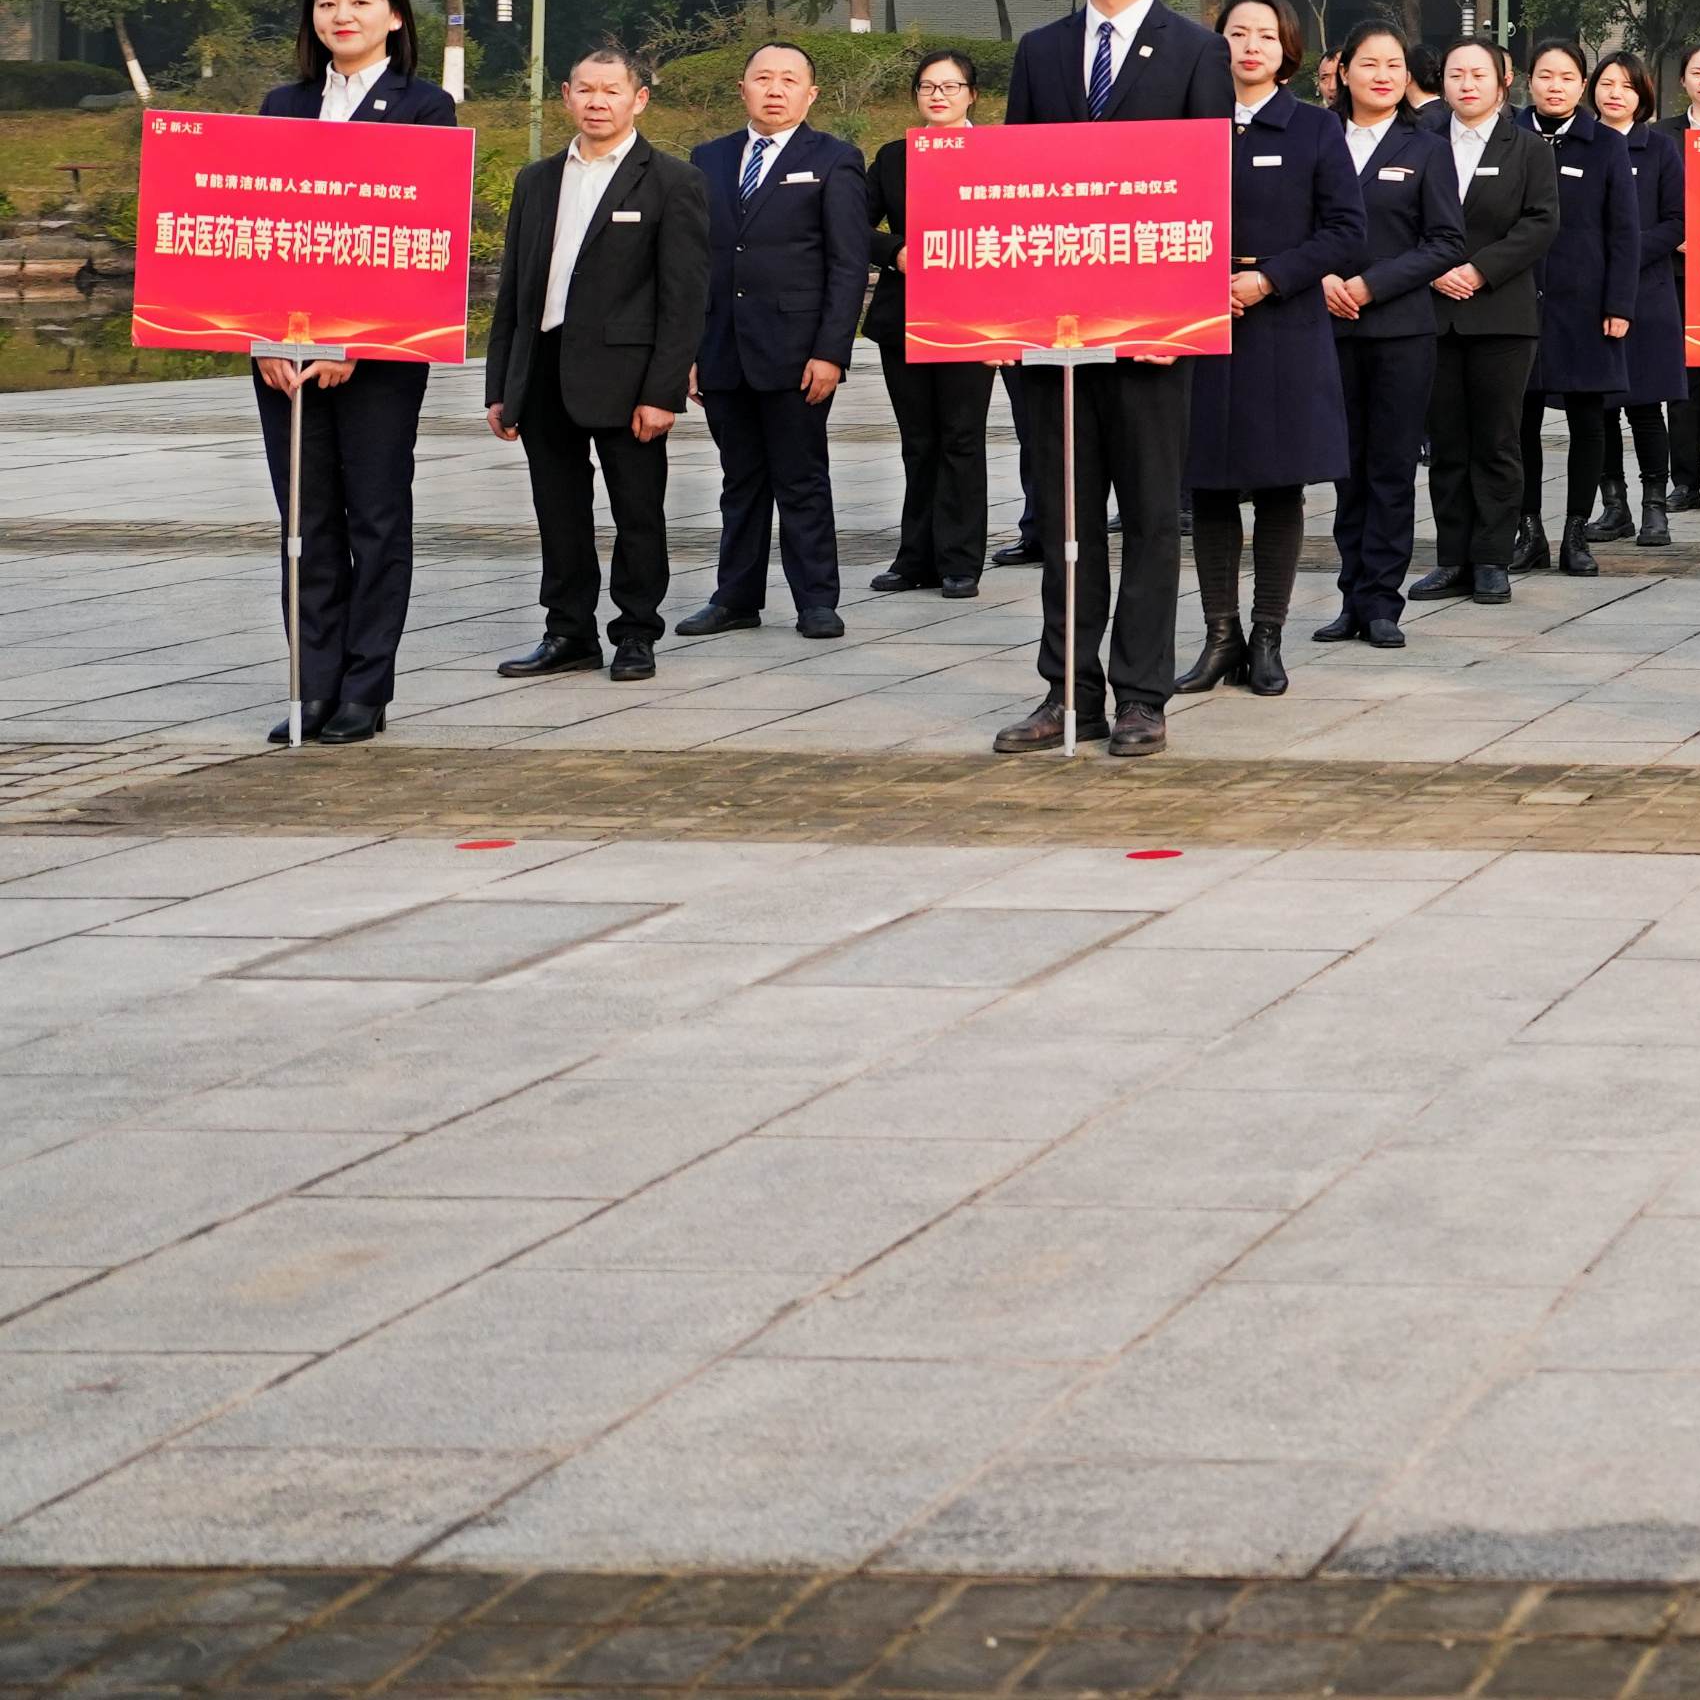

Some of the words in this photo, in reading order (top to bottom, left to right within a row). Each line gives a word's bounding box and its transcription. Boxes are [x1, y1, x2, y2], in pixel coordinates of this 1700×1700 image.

[170, 122, 203, 135] 新大正
[933, 137, 965, 149] 新大正
[195, 173, 417, 200] 智能清洁机器人全面推广启动仪式
[959, 180, 1177, 200] 智能清洁机器人全面推广启动仪式
[155, 212, 451, 271] 重庆医药高等专科学校项目管理部
[923, 220, 1213, 269] 四川美术学院项目管理部
